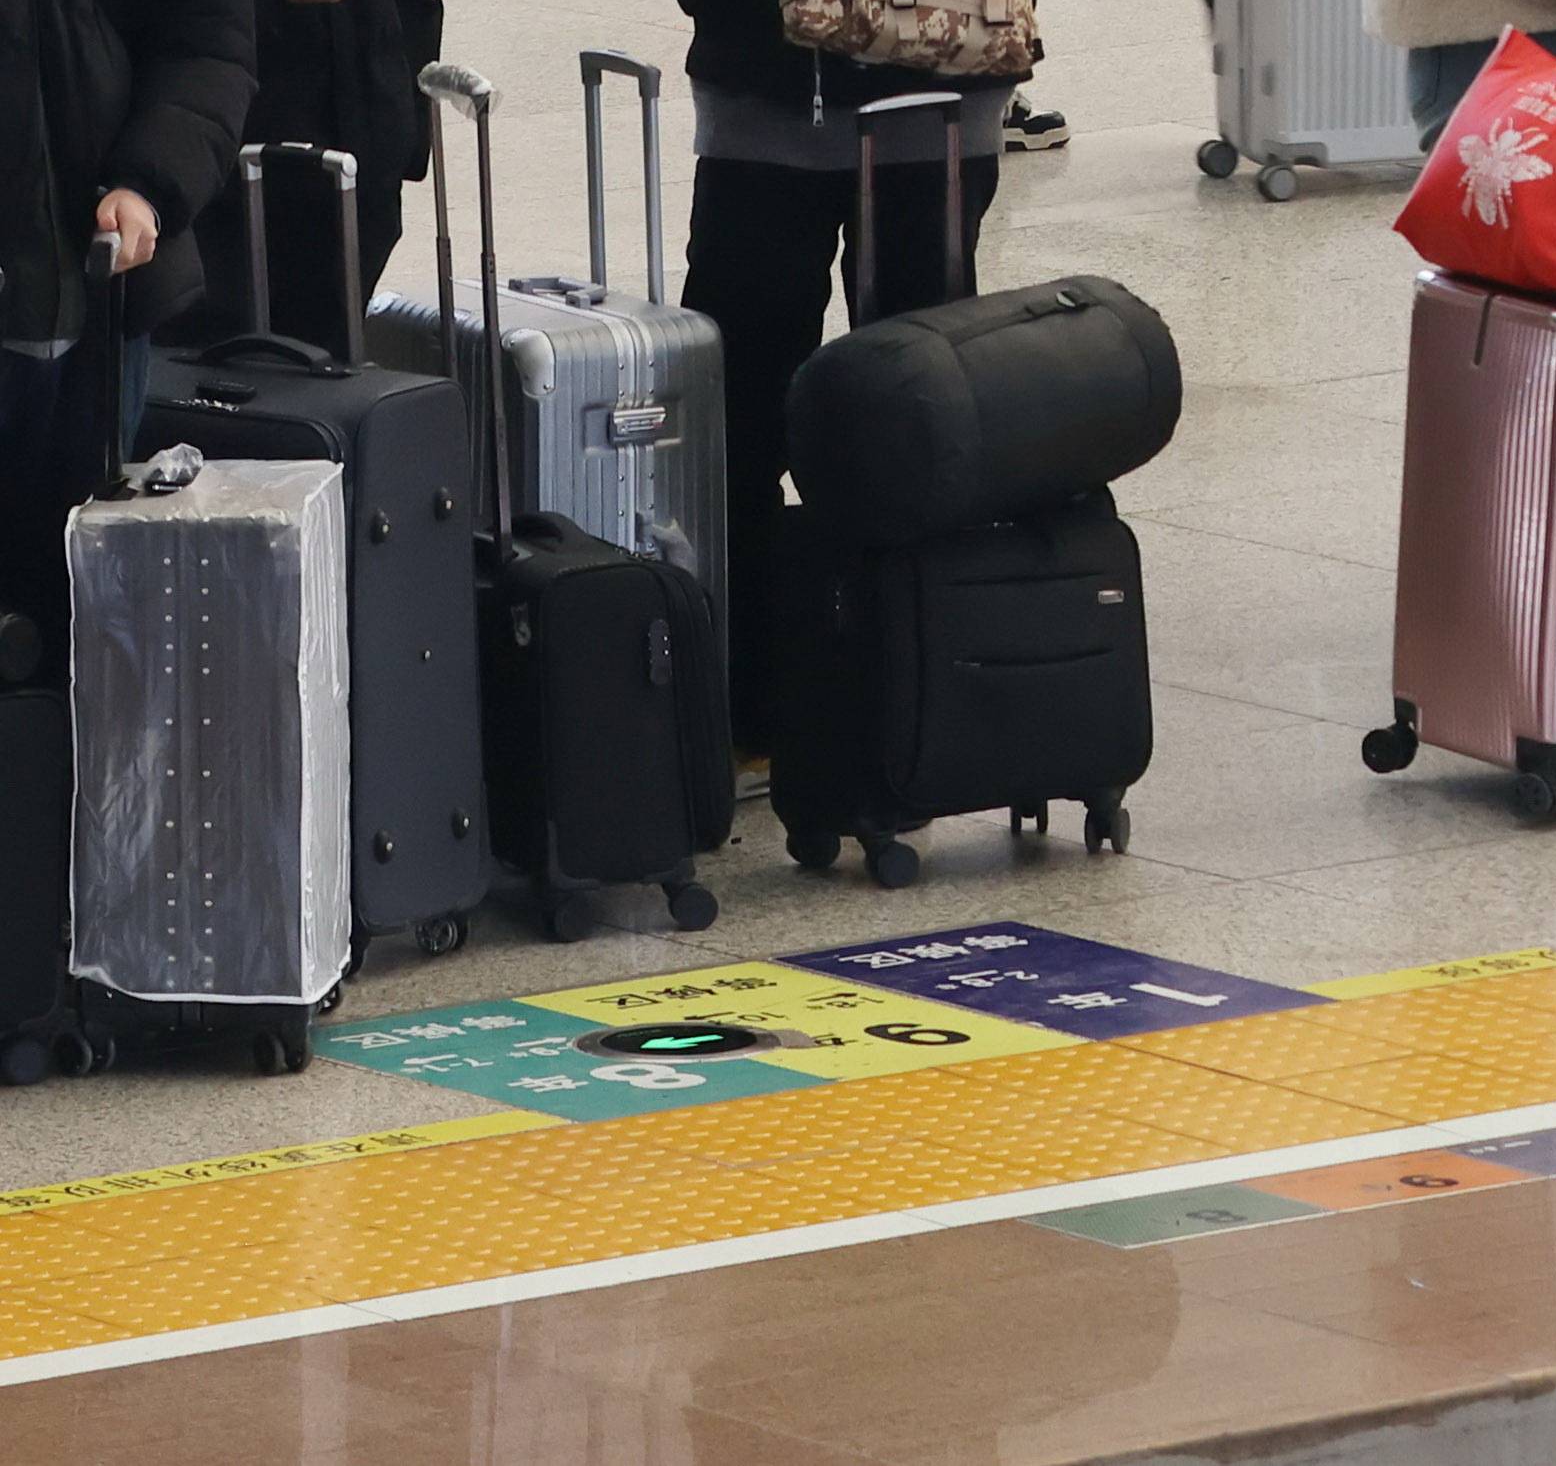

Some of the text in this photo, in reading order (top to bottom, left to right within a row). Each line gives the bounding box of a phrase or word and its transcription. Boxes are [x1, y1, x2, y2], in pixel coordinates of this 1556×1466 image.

[838, 935, 1029, 969] 等候区
[585, 977, 779, 1011] 等候区
[330, 1015, 527, 1050] 等候区
